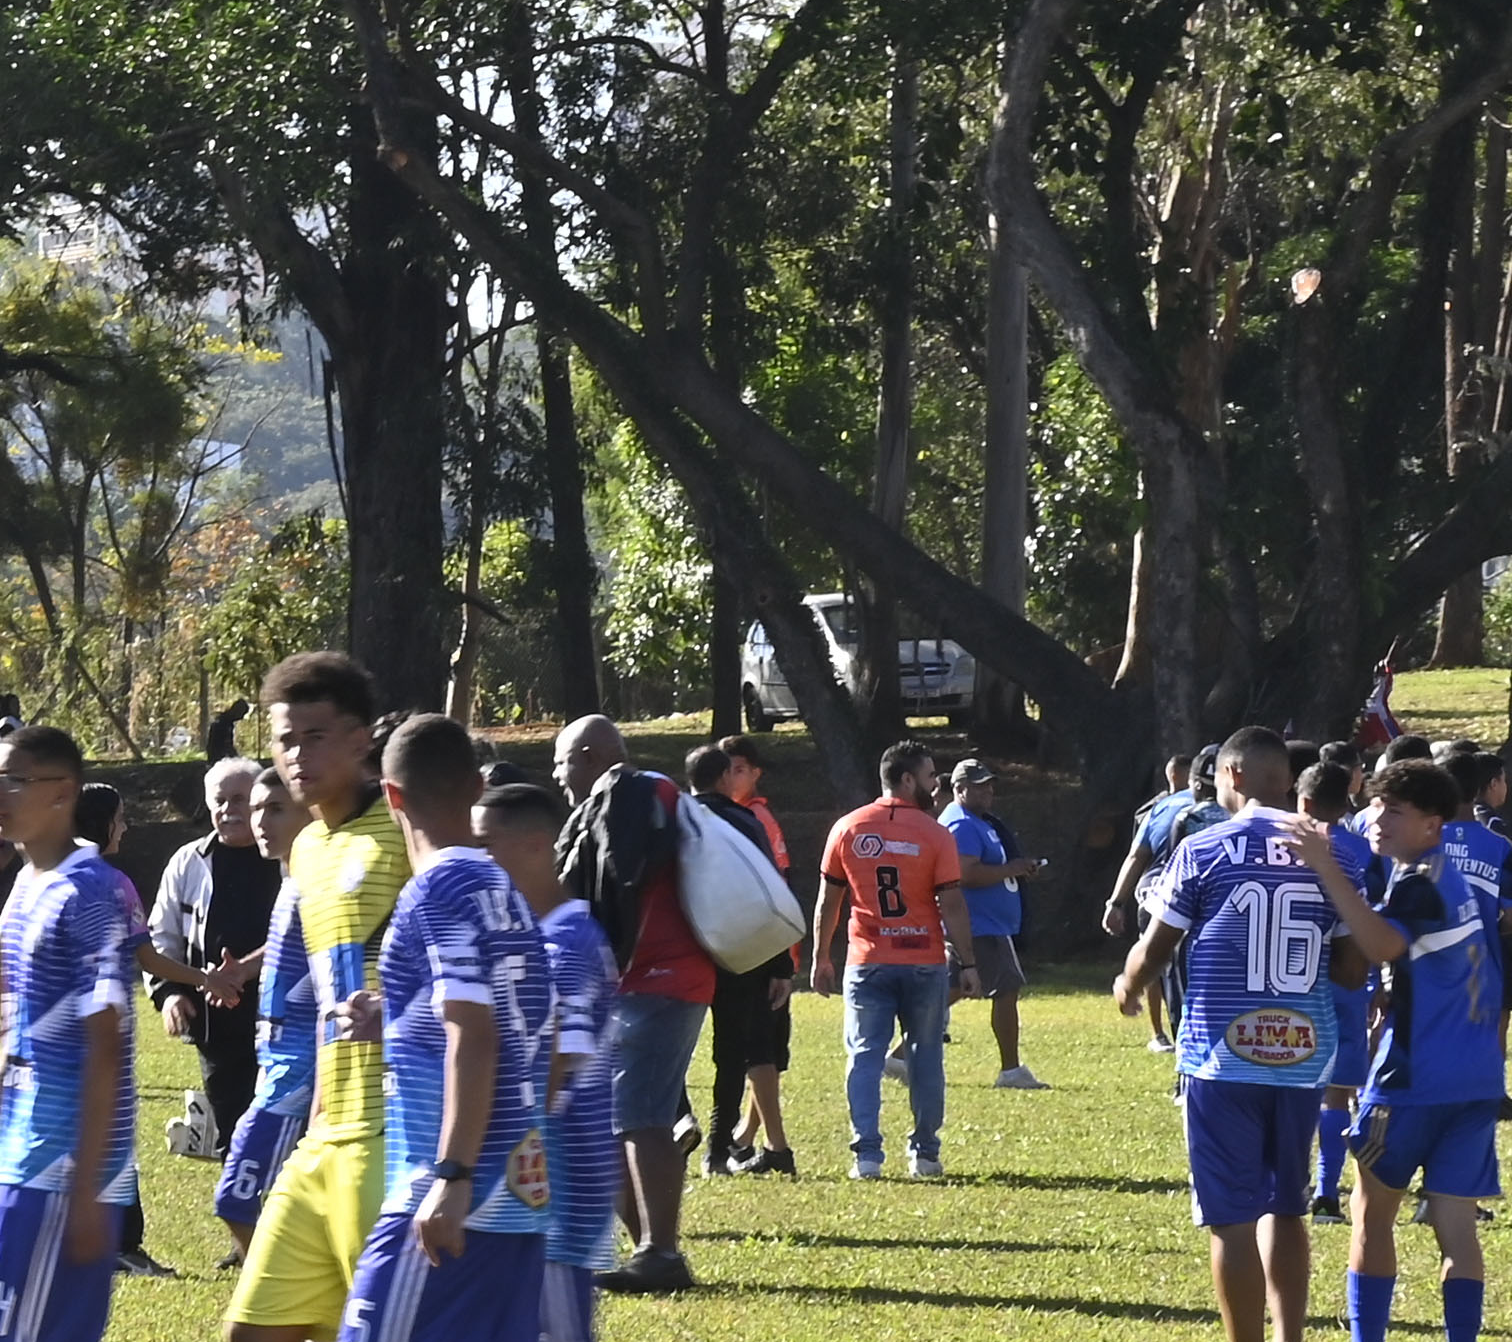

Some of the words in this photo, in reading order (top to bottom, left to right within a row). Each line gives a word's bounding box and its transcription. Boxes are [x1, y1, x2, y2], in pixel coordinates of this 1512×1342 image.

[875, 865, 908, 919] 8
[1230, 880, 1325, 995] 16
[1235, 1023, 1314, 1050] LIMA
[1256, 1014, 1291, 1026] TRUCK
[231, 1158, 262, 1201] 6
